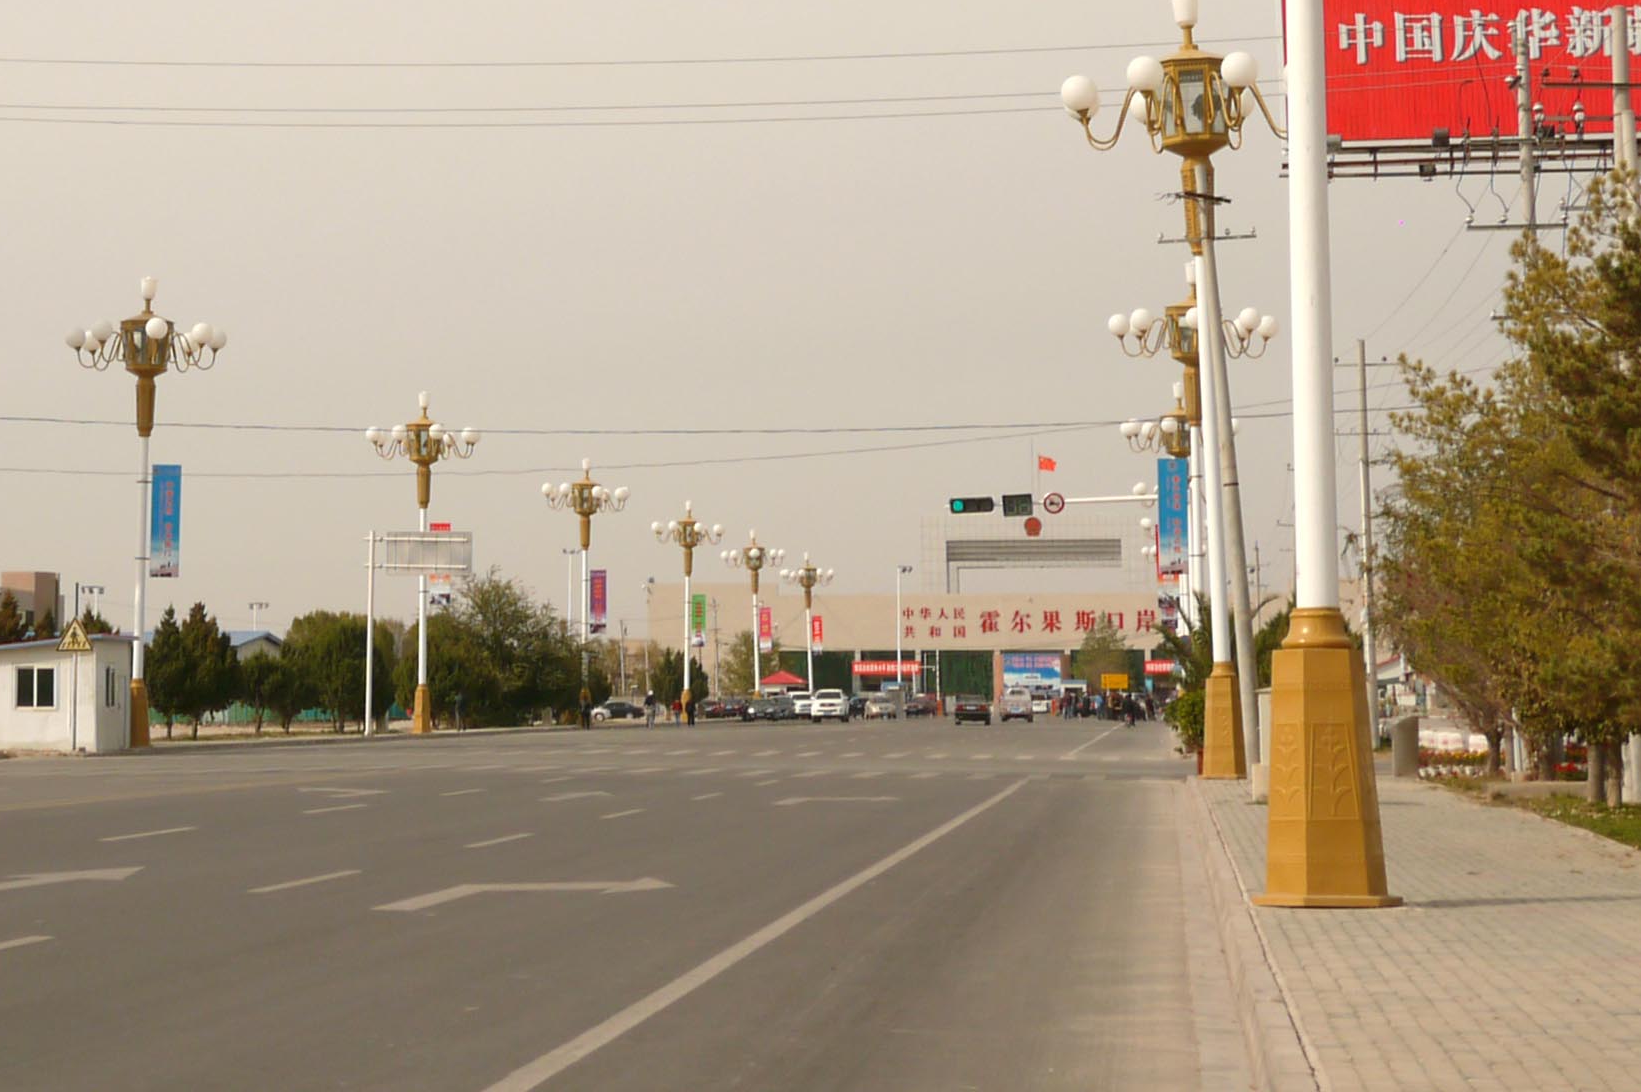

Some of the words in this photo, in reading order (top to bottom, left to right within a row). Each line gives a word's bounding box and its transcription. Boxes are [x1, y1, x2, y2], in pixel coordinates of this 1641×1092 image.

[979, 609, 1157, 634] 霍尔果斯口岸
